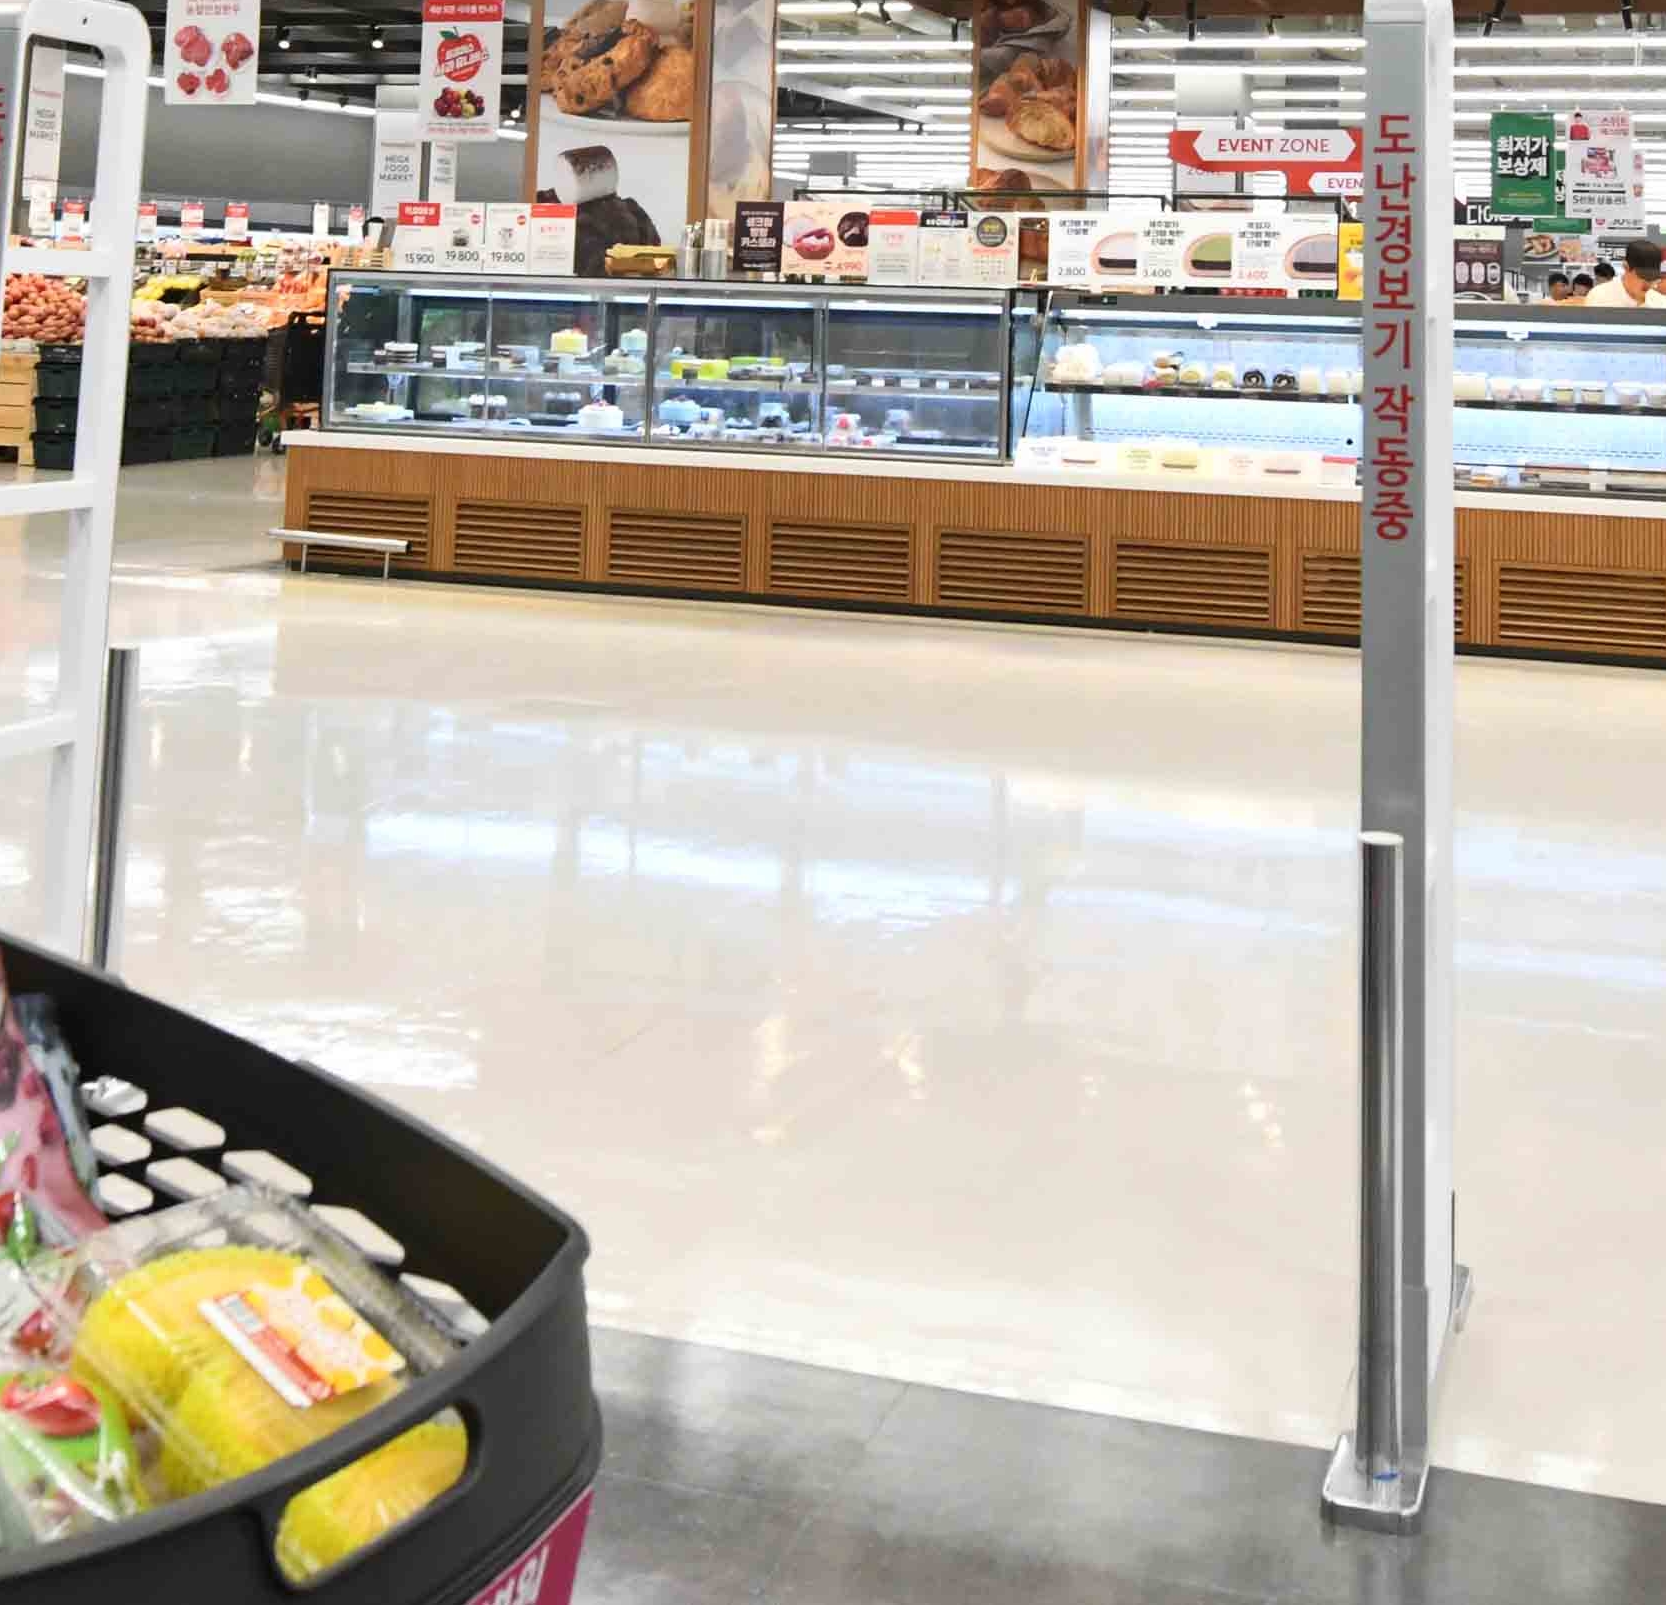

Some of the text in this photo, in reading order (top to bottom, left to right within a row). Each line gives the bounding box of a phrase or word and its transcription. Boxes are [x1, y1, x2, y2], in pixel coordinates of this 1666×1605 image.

[1218, 138, 1330, 153] EVENT ZONE
[1496, 136, 1549, 157] 최저가
[385, 164, 410, 173] FOOD
[1497, 157, 1548, 177] 보상제
[380, 173, 413, 182] MARKET
[1328, 178, 1363, 189] EVEN
[1370, 114, 1417, 542] 도난경보기 작동중
